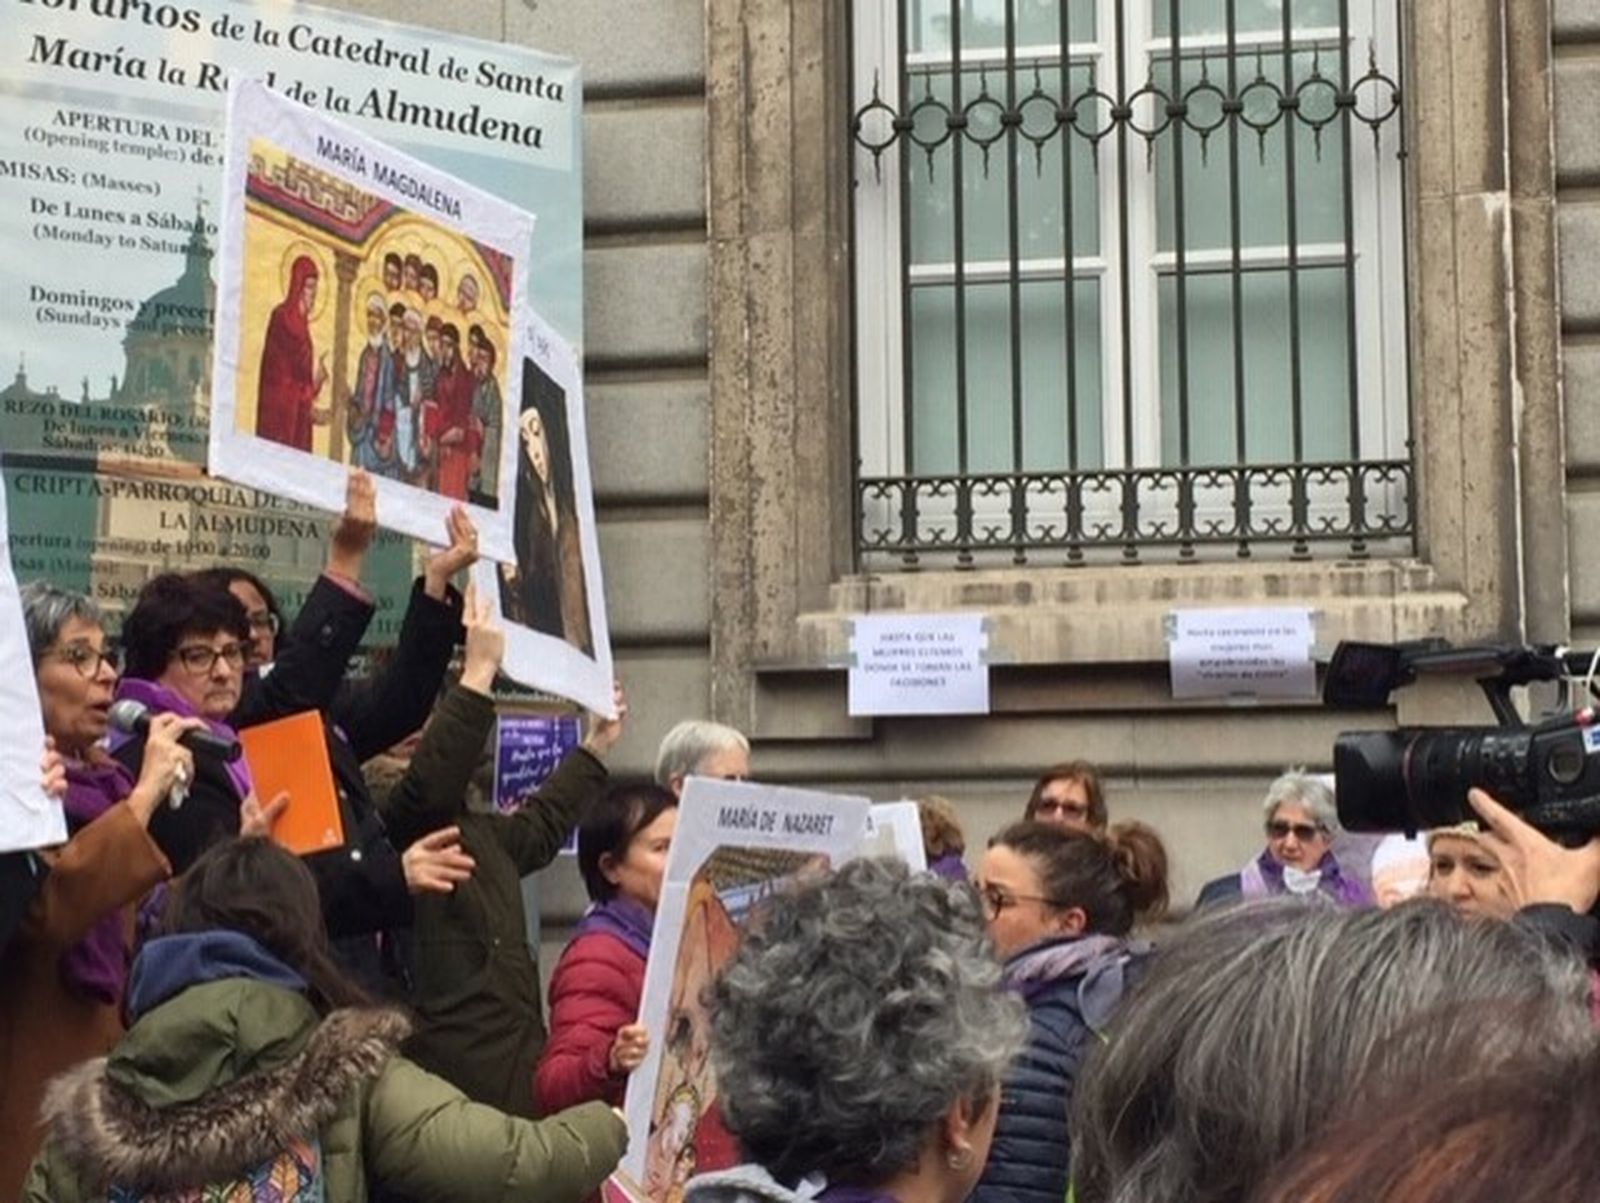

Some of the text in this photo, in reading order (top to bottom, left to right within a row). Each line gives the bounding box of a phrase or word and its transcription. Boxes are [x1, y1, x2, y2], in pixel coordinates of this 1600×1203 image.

[211, 14, 245, 41] de
[253, 20, 279, 47] la
[288, 23, 430, 76] Catedral
[438, 57, 468, 83] de
[475, 60, 565, 102] Santa
[28, 34, 147, 80] María
[157, 58, 185, 86] la
[284, 81, 317, 106] de
[324, 86, 350, 113] la
[356, 87, 543, 149] Almudena
[52, 109, 218, 148] APERTURA DEL
[24, 126, 109, 154] (Opening
[191, 148, 214, 165] de
[0, 159, 161, 196] MISAS: (Masses)
[316, 136, 462, 221] MARÍA MAGDALENA
[30, 197, 219, 236] De Lunes a Sábado
[33, 223, 114, 249] (Monday
[119, 234, 136, 248] to
[30, 285, 135, 314] Domingos
[35, 306, 121, 331] (Sundays
[5, 399, 56, 417] REZO
[43, 418, 66, 433] De
[160, 511, 320, 540] LA ALMUDENA
[10, 532, 72, 551] pertura
[151, 538, 172, 554] de
[717, 805, 834, 836] MARÍA DE NAZARET
